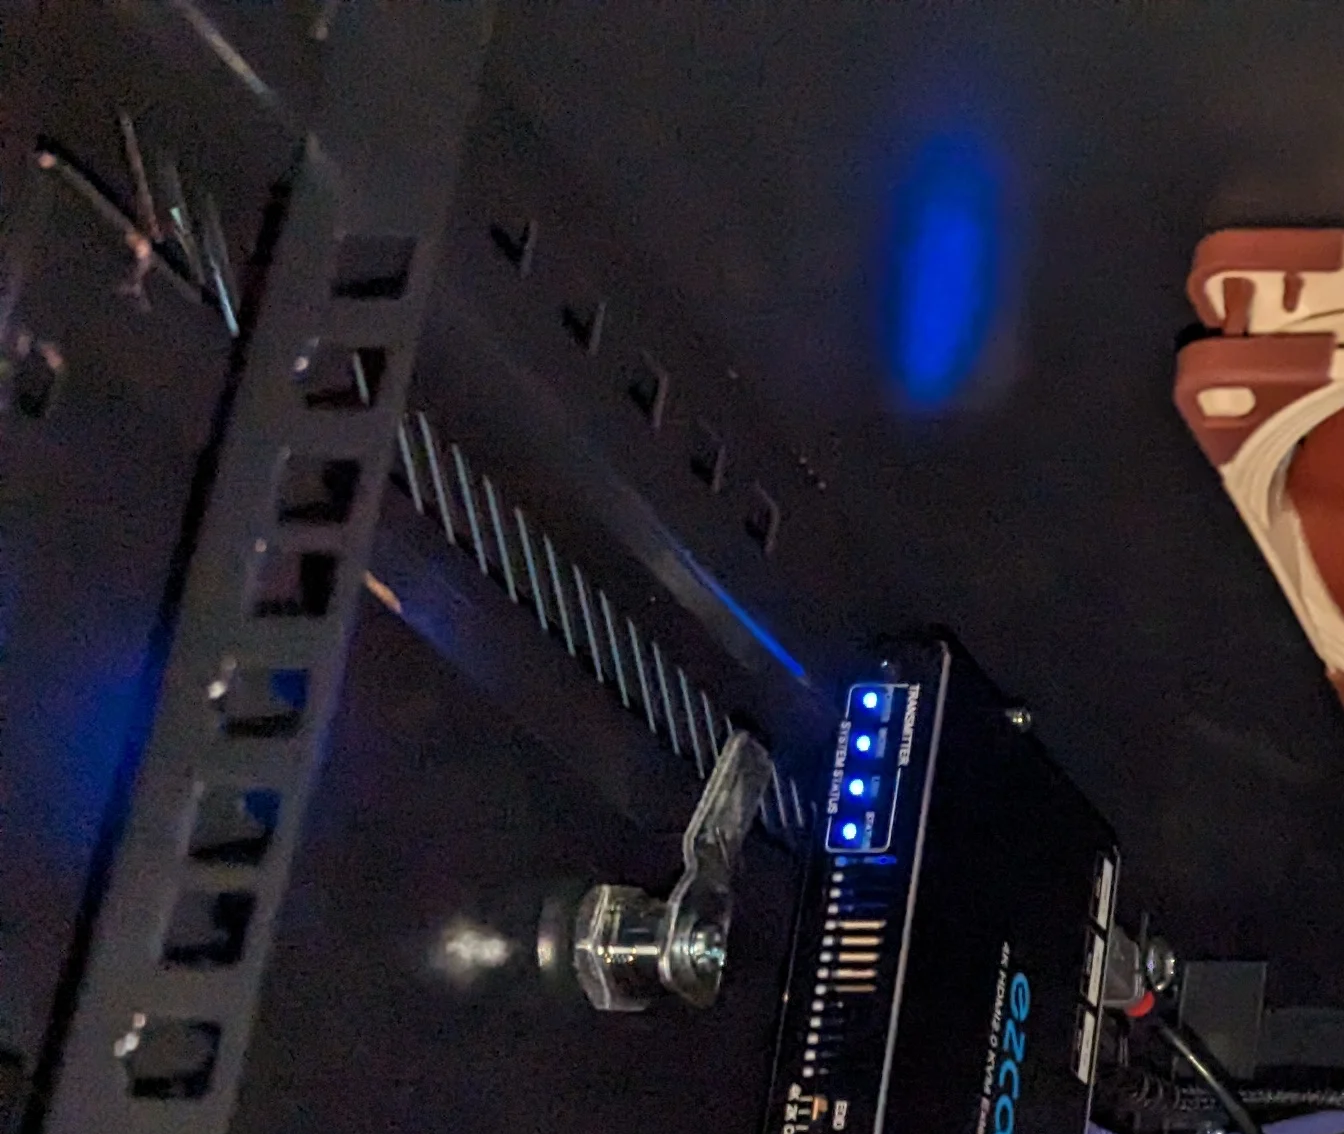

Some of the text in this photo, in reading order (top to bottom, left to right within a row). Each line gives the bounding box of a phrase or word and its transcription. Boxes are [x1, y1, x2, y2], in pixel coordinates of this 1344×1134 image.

[899, 683, 921, 767] TRANSMITTER
[827, 720, 851, 815] SYSTEM STATUS
[982, 1049, 998, 1095] KVM
